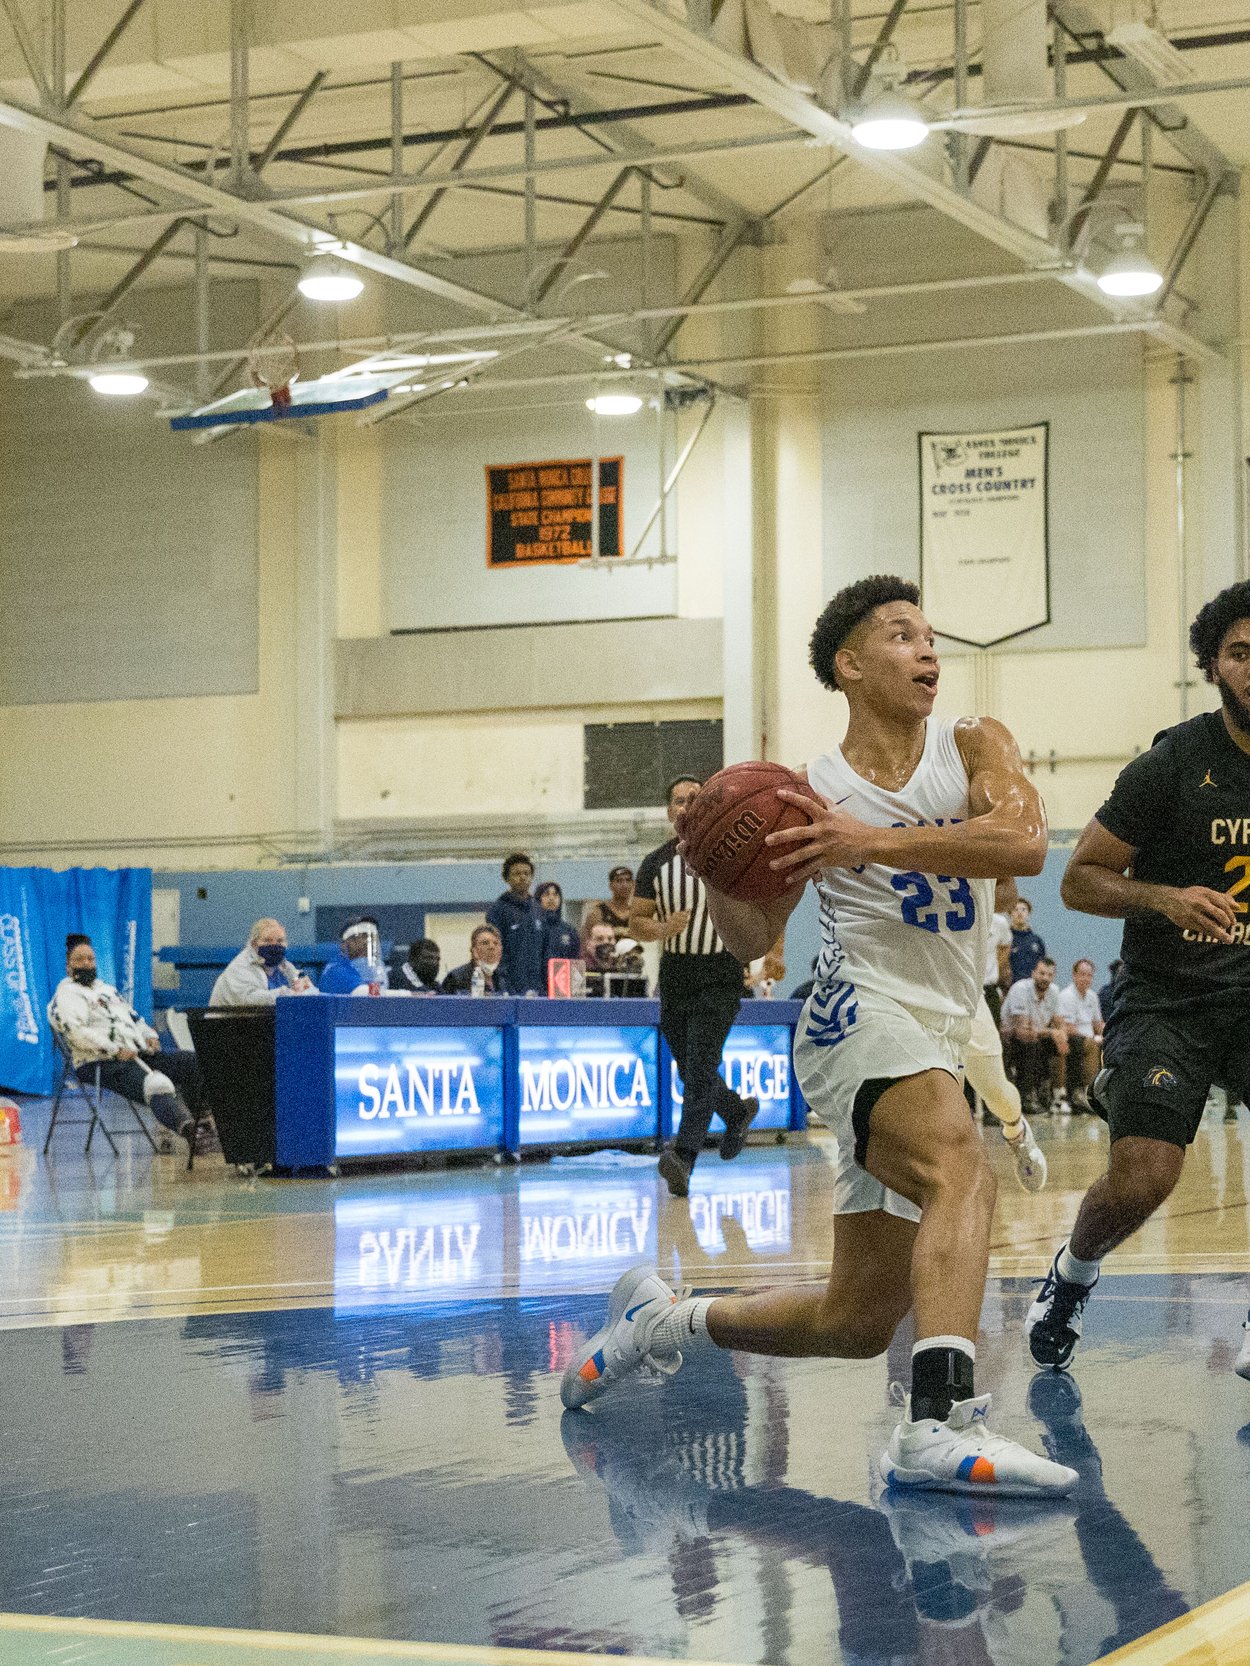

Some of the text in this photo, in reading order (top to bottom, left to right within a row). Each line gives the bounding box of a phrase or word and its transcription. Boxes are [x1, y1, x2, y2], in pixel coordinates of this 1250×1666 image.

[931, 477, 1036, 496] CROSS COUNTRY
[965, 466, 1003, 478] MEN'S
[889, 871, 975, 933] 23
[358, 1063, 482, 1120] SANTA
[521, 1057, 652, 1112] MONICA
